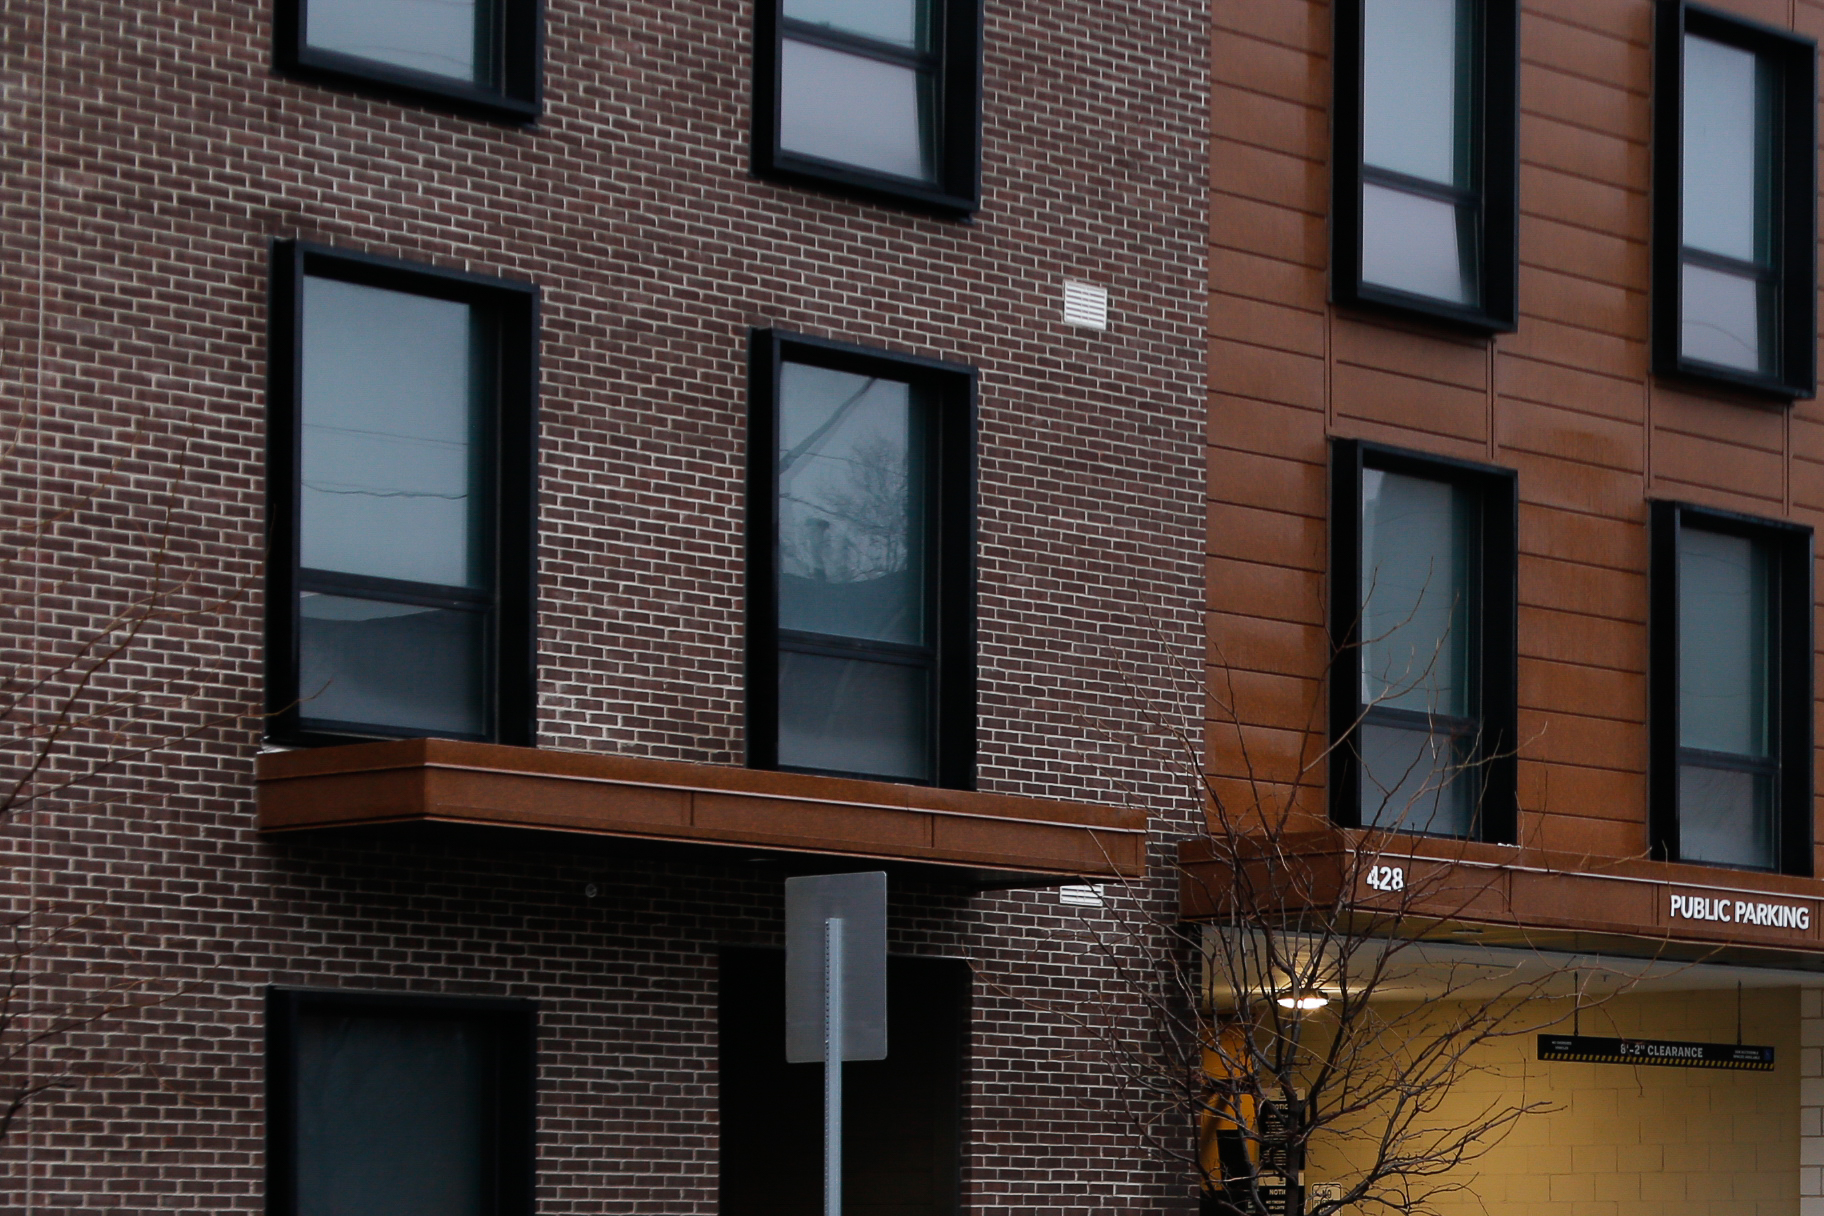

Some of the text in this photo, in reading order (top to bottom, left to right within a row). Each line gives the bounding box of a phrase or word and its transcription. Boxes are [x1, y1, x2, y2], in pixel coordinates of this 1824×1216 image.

[1366, 865, 1404, 892] 428
[1670, 895, 1810, 930] PUBLIC PARKING
[1647, 1045, 1703, 1058] CLEARANCE
